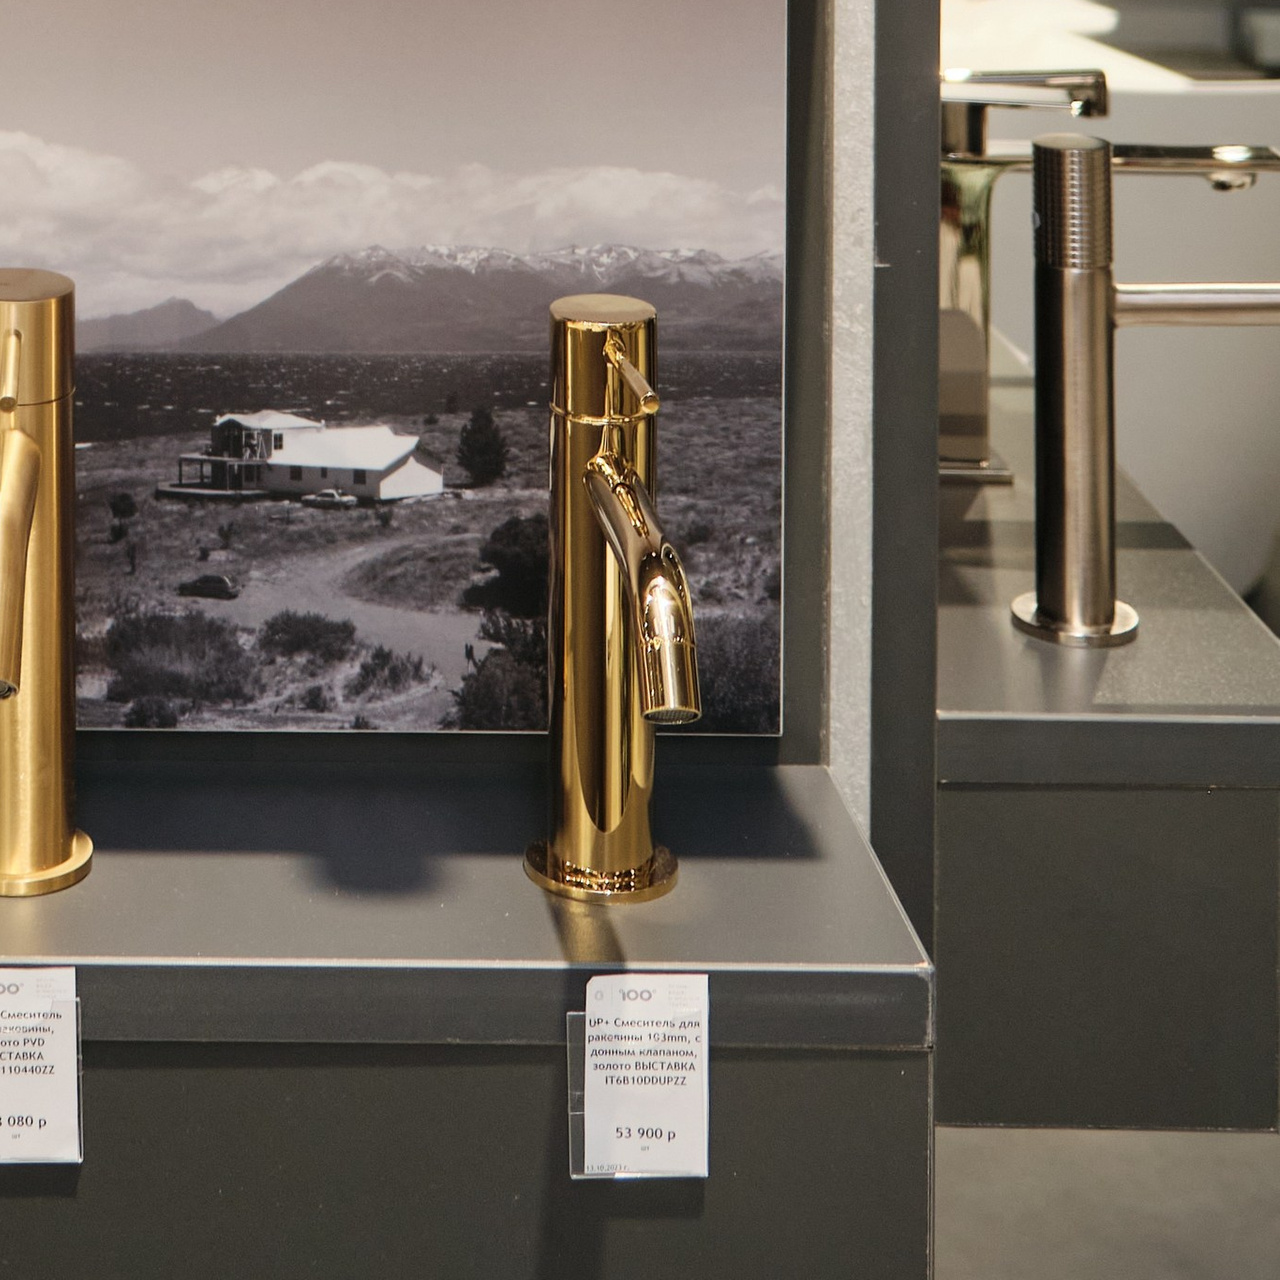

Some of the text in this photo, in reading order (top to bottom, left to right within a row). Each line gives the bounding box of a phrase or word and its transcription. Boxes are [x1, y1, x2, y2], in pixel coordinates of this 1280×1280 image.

[1, 1011, 62, 1019] Смеситель
[589, 1018, 700, 1028] UP+ Смеситель для
[24, 1038, 45, 1047] PVD
[588, 1034, 642, 1043] раковины
[591, 1049, 697, 1058] донным клапаном,
[593, 1062, 695, 1071] золото ВЫСТАВКА
[8, 1116, 33, 1127] 080
[616, 1127, 632, 1139] 53
[638, 1128, 663, 1139] 900
